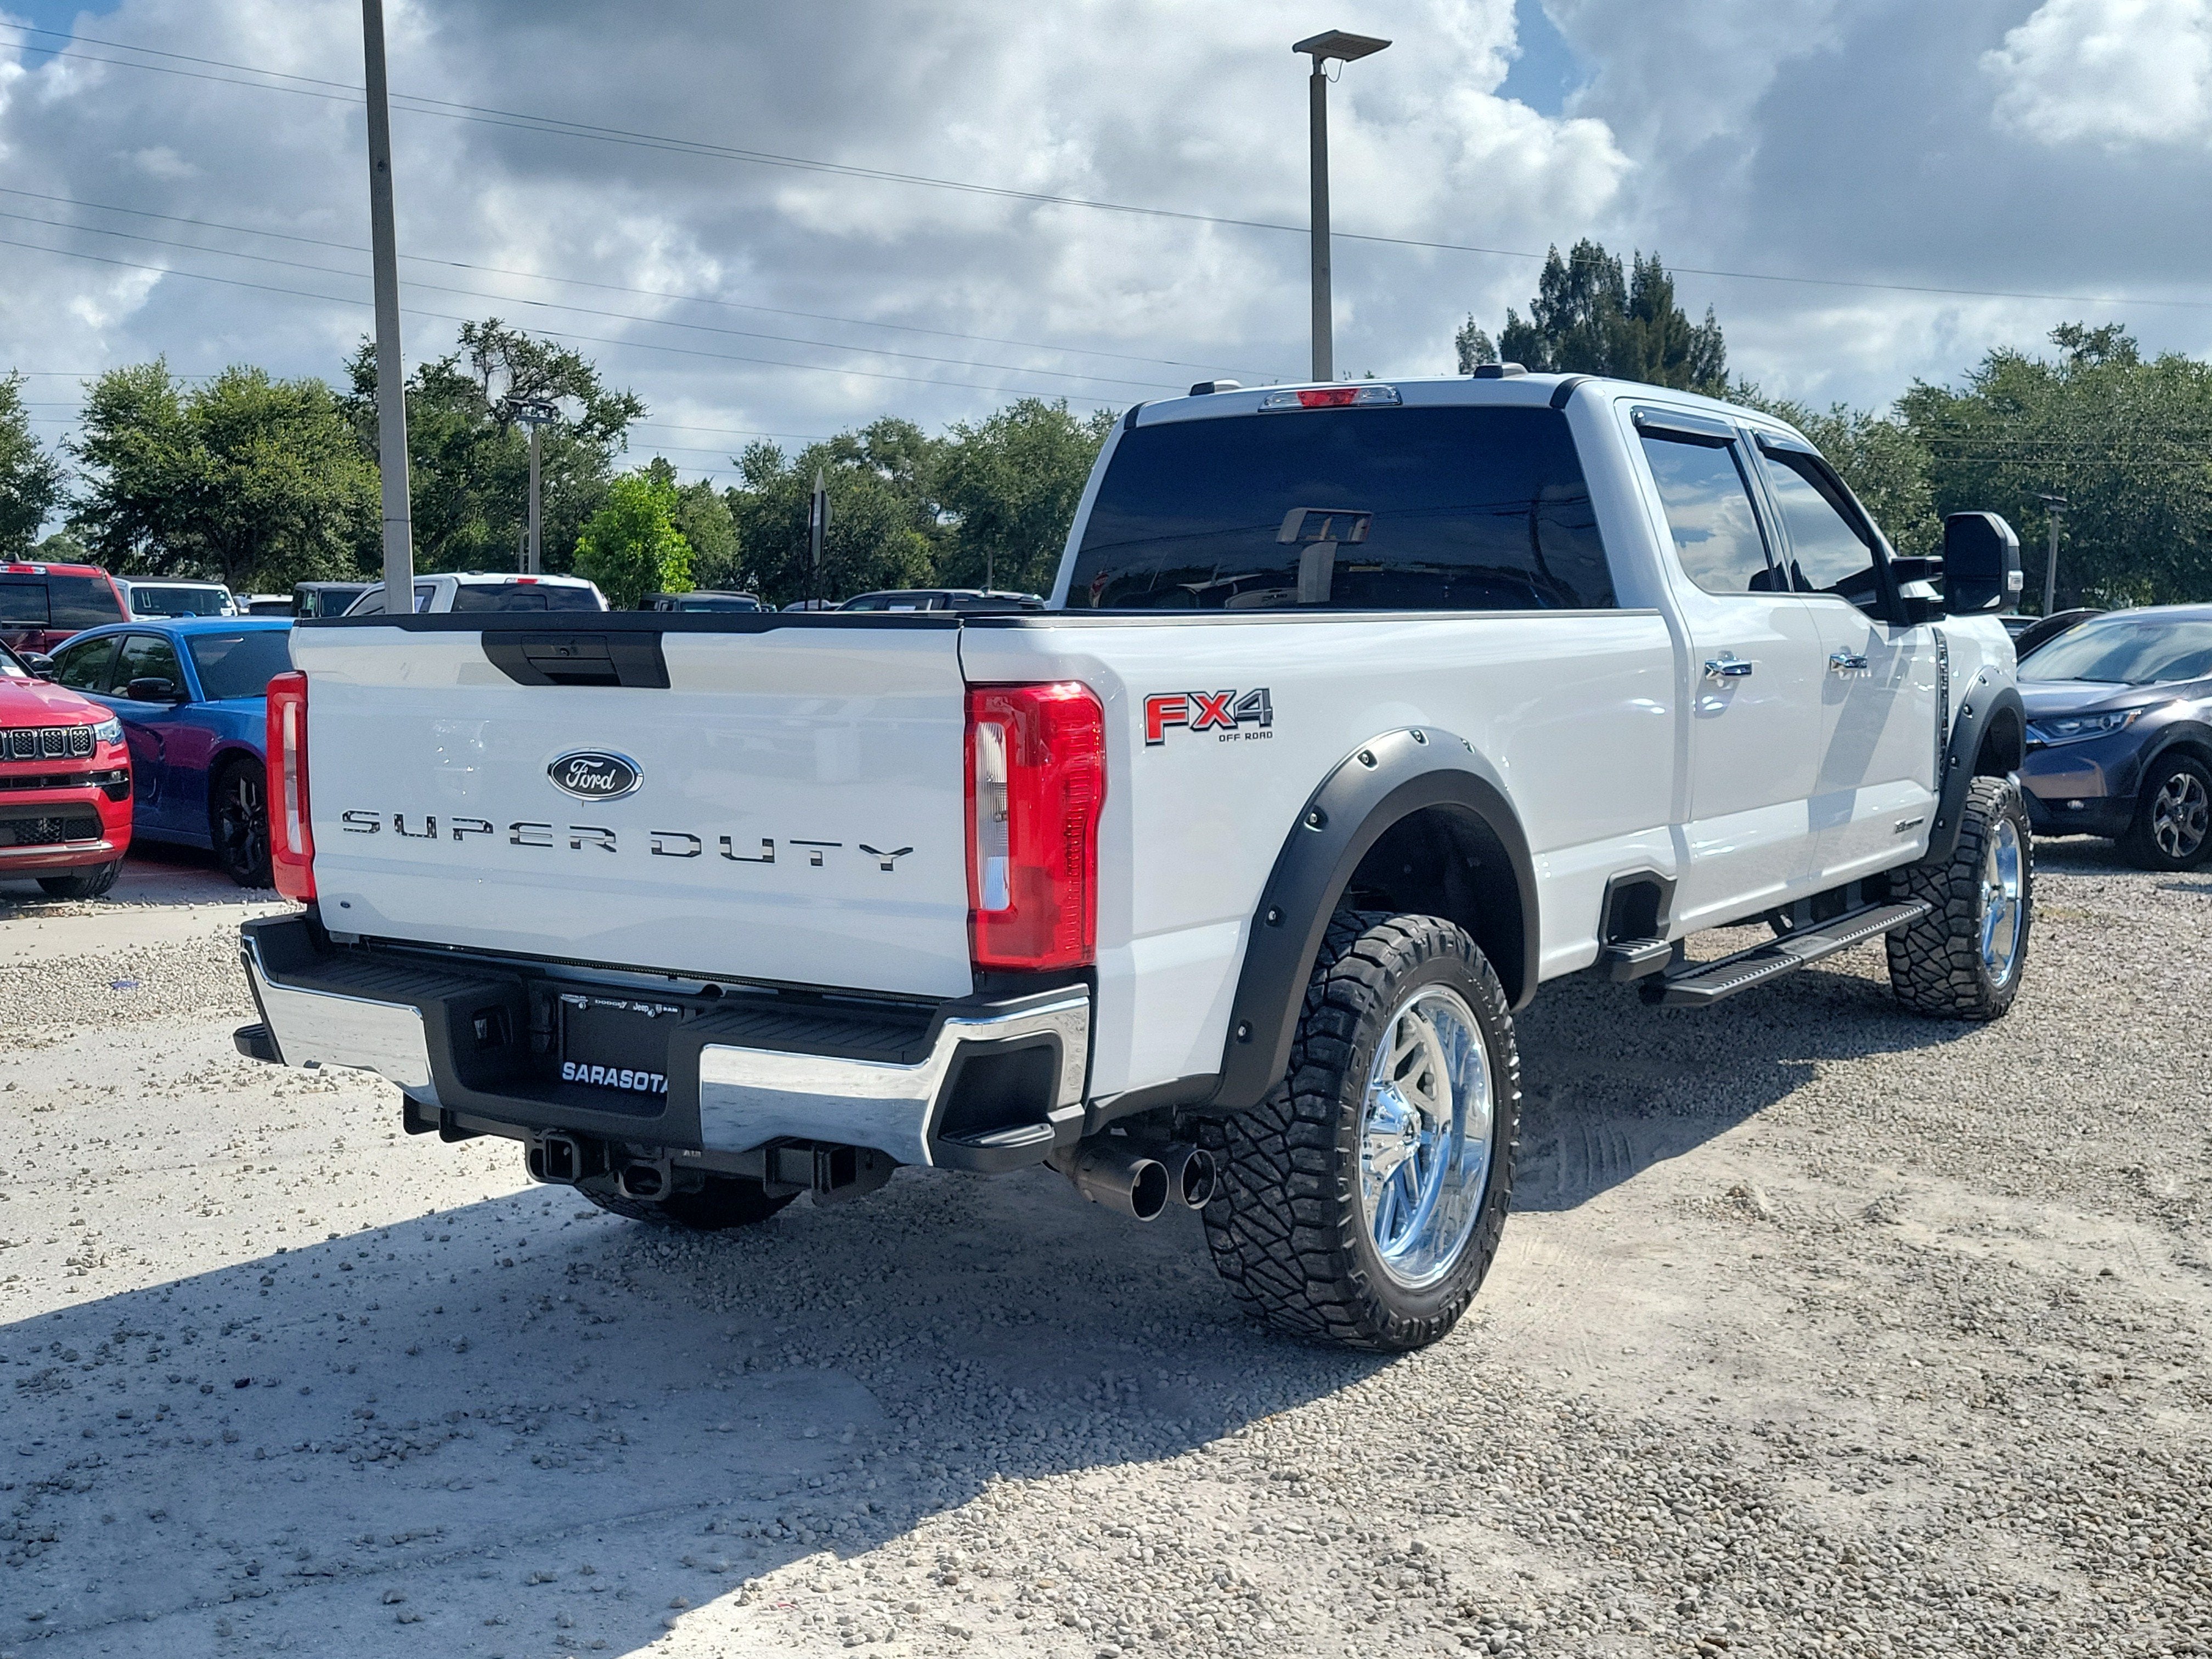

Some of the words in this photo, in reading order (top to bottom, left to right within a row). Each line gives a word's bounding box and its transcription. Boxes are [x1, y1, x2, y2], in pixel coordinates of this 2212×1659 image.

[1143, 688, 1273, 746] FX4
[1219, 733, 1240, 742] OFF
[1245, 731, 1273, 740] ROAD
[566, 759, 617, 790] Ford
[342, 810, 617, 853] SUPER
[651, 831, 914, 871] DUTY
[633, 1002, 649, 1013] Jeep
